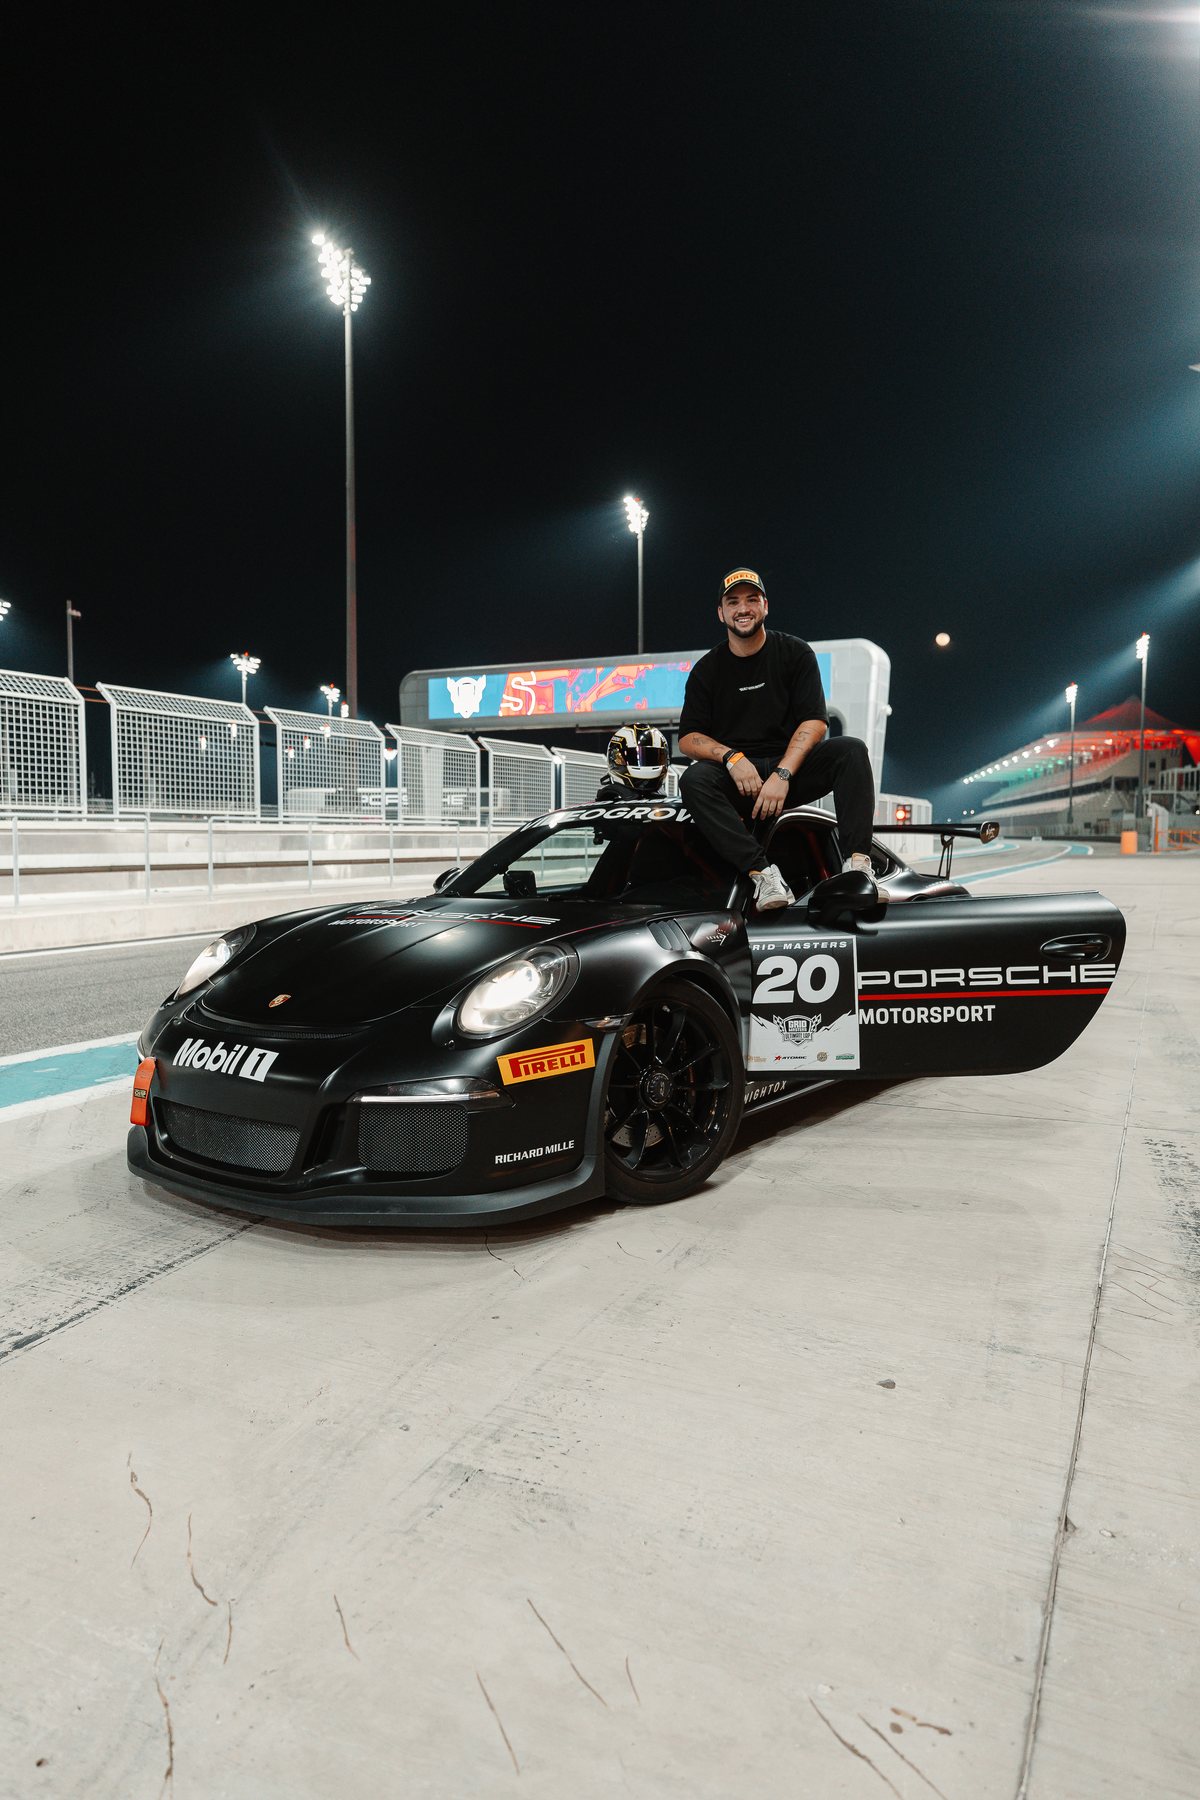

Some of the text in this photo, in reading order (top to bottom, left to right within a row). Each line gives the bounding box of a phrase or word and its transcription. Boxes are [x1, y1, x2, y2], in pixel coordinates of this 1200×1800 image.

[356, 909, 561, 925] PORSCHE
[783, 941, 848, 950] MASTERS
[752, 954, 840, 1004] 20
[857, 964, 1116, 989] PORSCHE
[788, 1020, 807, 1028] GRID
[859, 1005, 996, 1025] MOTORSPORT
[172, 1038, 248, 1075] Mobil
[508, 1044, 586, 1078] PIRELLI
[495, 1140, 575, 1164] RICHARD MILLE
